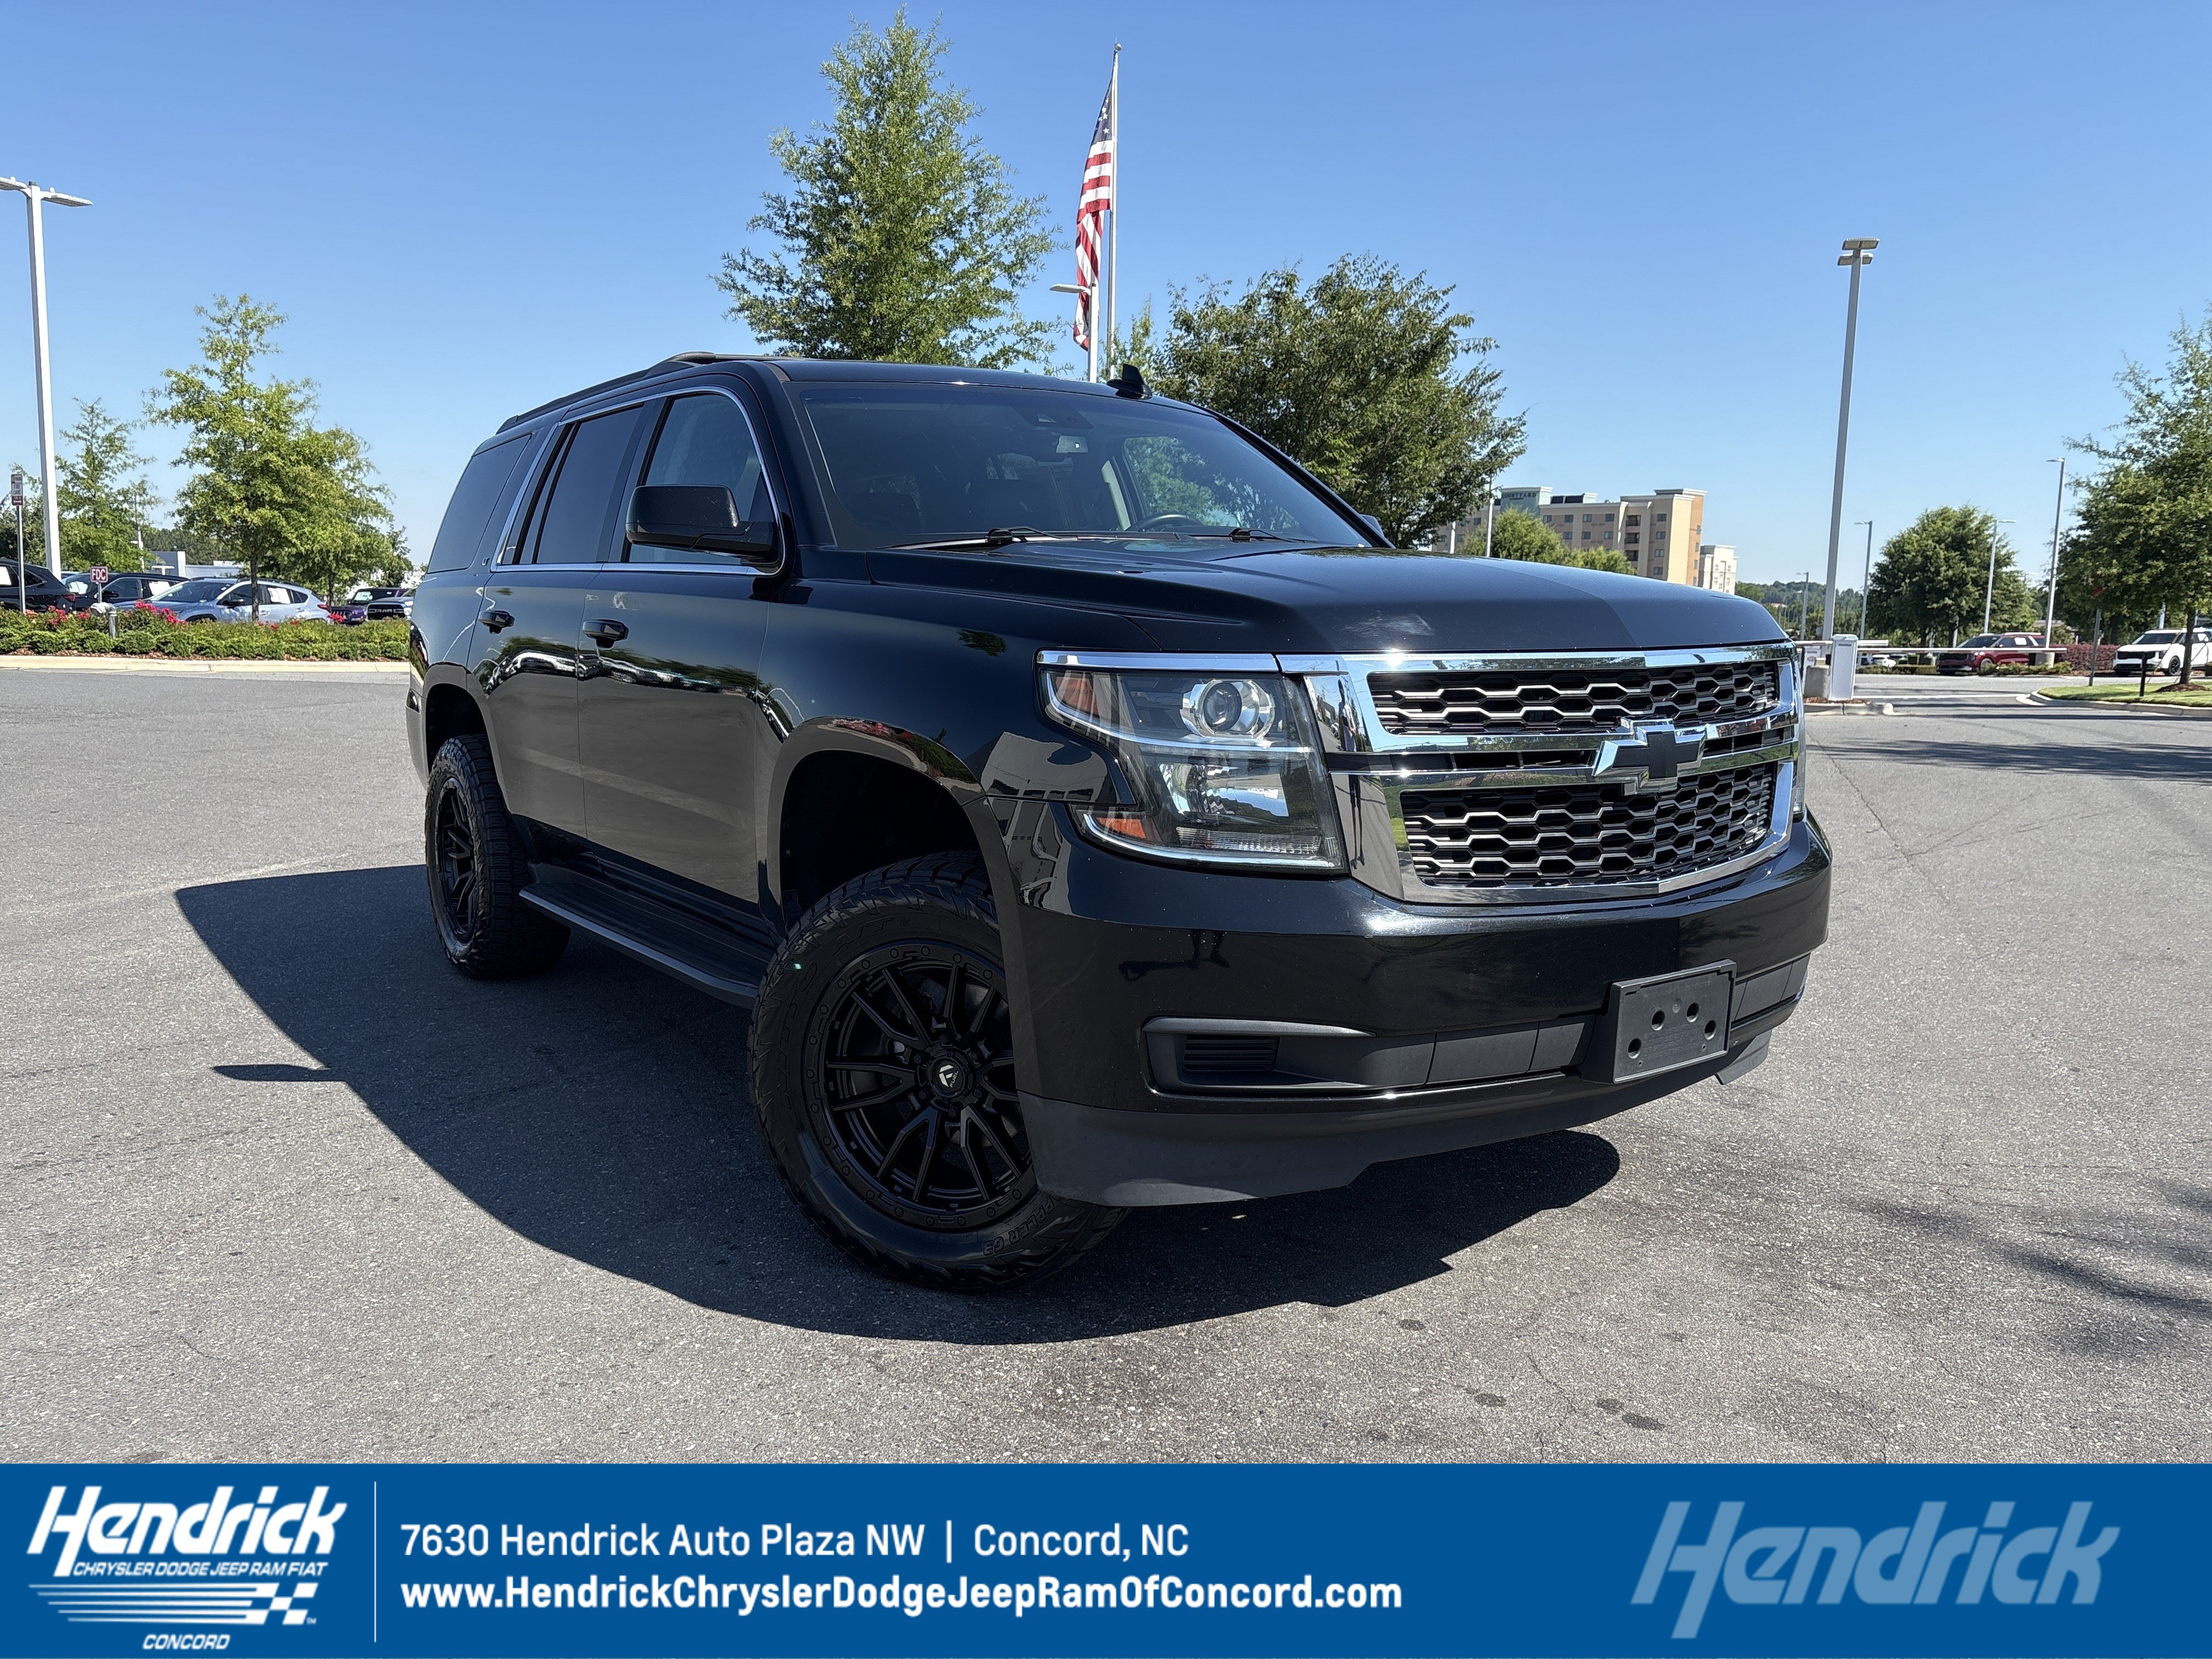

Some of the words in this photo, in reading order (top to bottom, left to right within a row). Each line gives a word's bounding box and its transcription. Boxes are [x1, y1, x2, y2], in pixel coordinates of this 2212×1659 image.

[92, 568, 106, 580] FDC
[949, 1070, 959, 1088] FUEL
[983, 1236, 1005, 1256] G3
